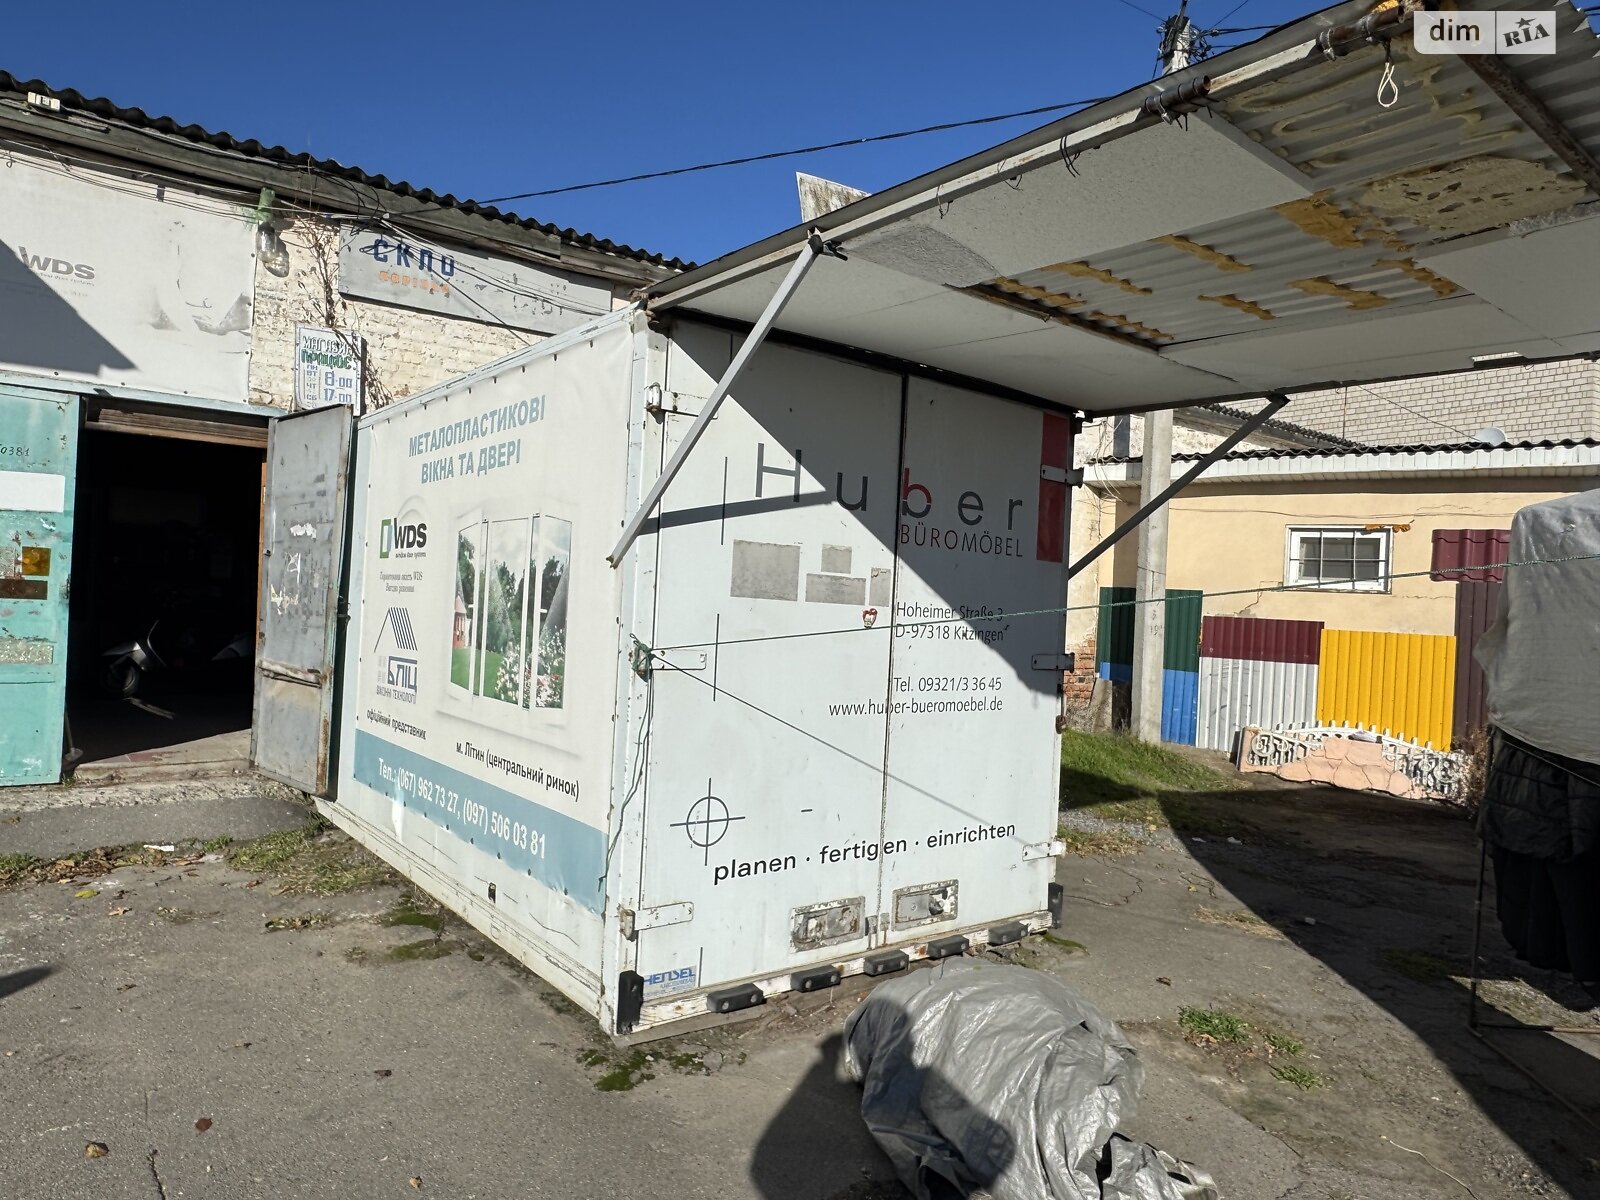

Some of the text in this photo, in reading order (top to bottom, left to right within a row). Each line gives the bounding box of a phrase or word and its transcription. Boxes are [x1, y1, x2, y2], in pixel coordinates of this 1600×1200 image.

[18, 245, 95, 280] WDS
[408, 394, 546, 458] МЕТАЛОПЛАСТИКОВІ
[0, 444, 30, 457] 0381
[421, 438, 521, 484] ВІКНА ТА ДВЕРІ
[754, 442, 1023, 530] Huber
[393, 517, 427, 550] WDS
[899, 521, 1023, 558] BÜROMÖBEL
[896, 601, 1003, 622] Hoheimer Straße 3
[895, 623, 1004, 645] D-97318 Kitzingen
[893, 676, 914, 692] Tel.
[988, 676, 1002, 691] 45
[828, 696, 1003, 716] www.huber-bueromoebel.de
[456, 741, 580, 803] м. Літин (центральний ринок)
[397, 767, 416, 798] (067)
[417, 776, 433, 802] 962
[435, 784, 446, 808] 73
[447, 790, 461, 820] 27,
[463, 797, 489, 835] (097)
[490, 810, 511, 841] 506
[513, 821, 528, 850] 03
[530, 830, 546, 859] 81
[713, 823, 1016, 885] planen fertigen einrichten
